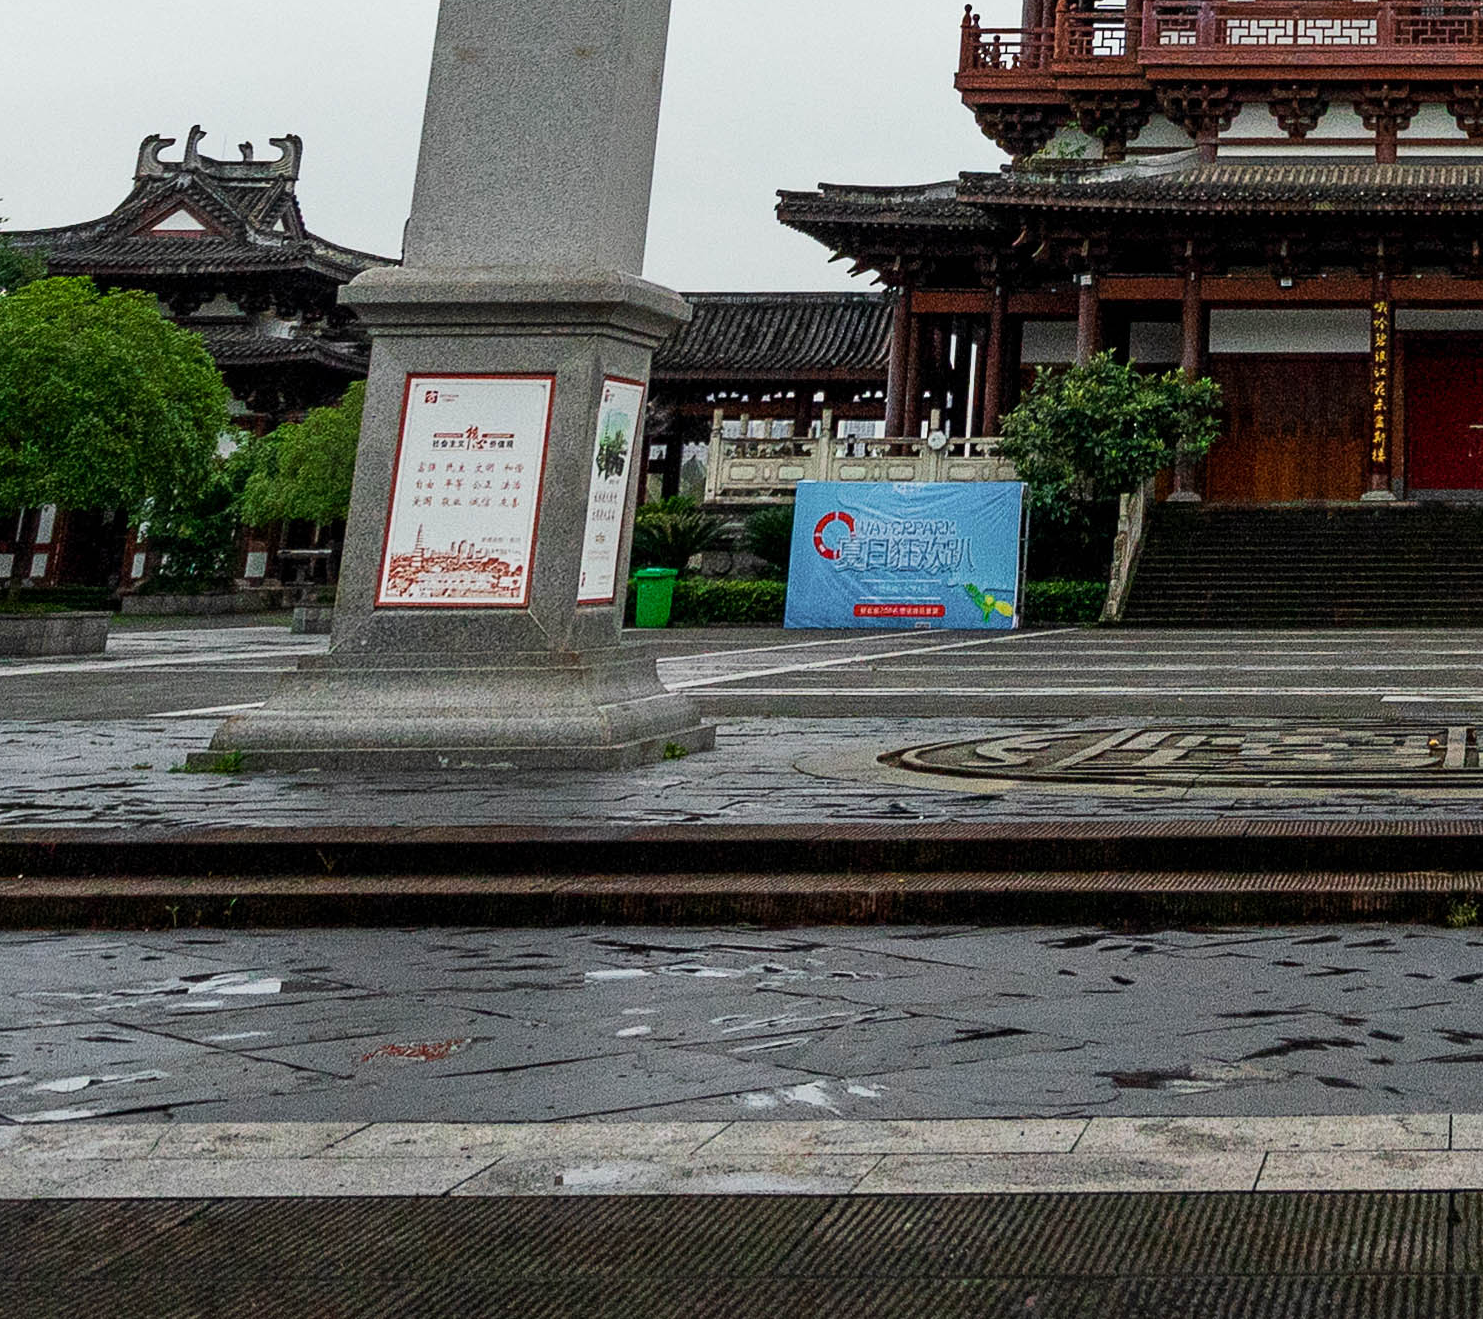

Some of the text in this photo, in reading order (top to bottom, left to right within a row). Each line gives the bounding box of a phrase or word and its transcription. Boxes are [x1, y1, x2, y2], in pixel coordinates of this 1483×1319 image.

[838, 535, 974, 572] 夏日狂欢趴
